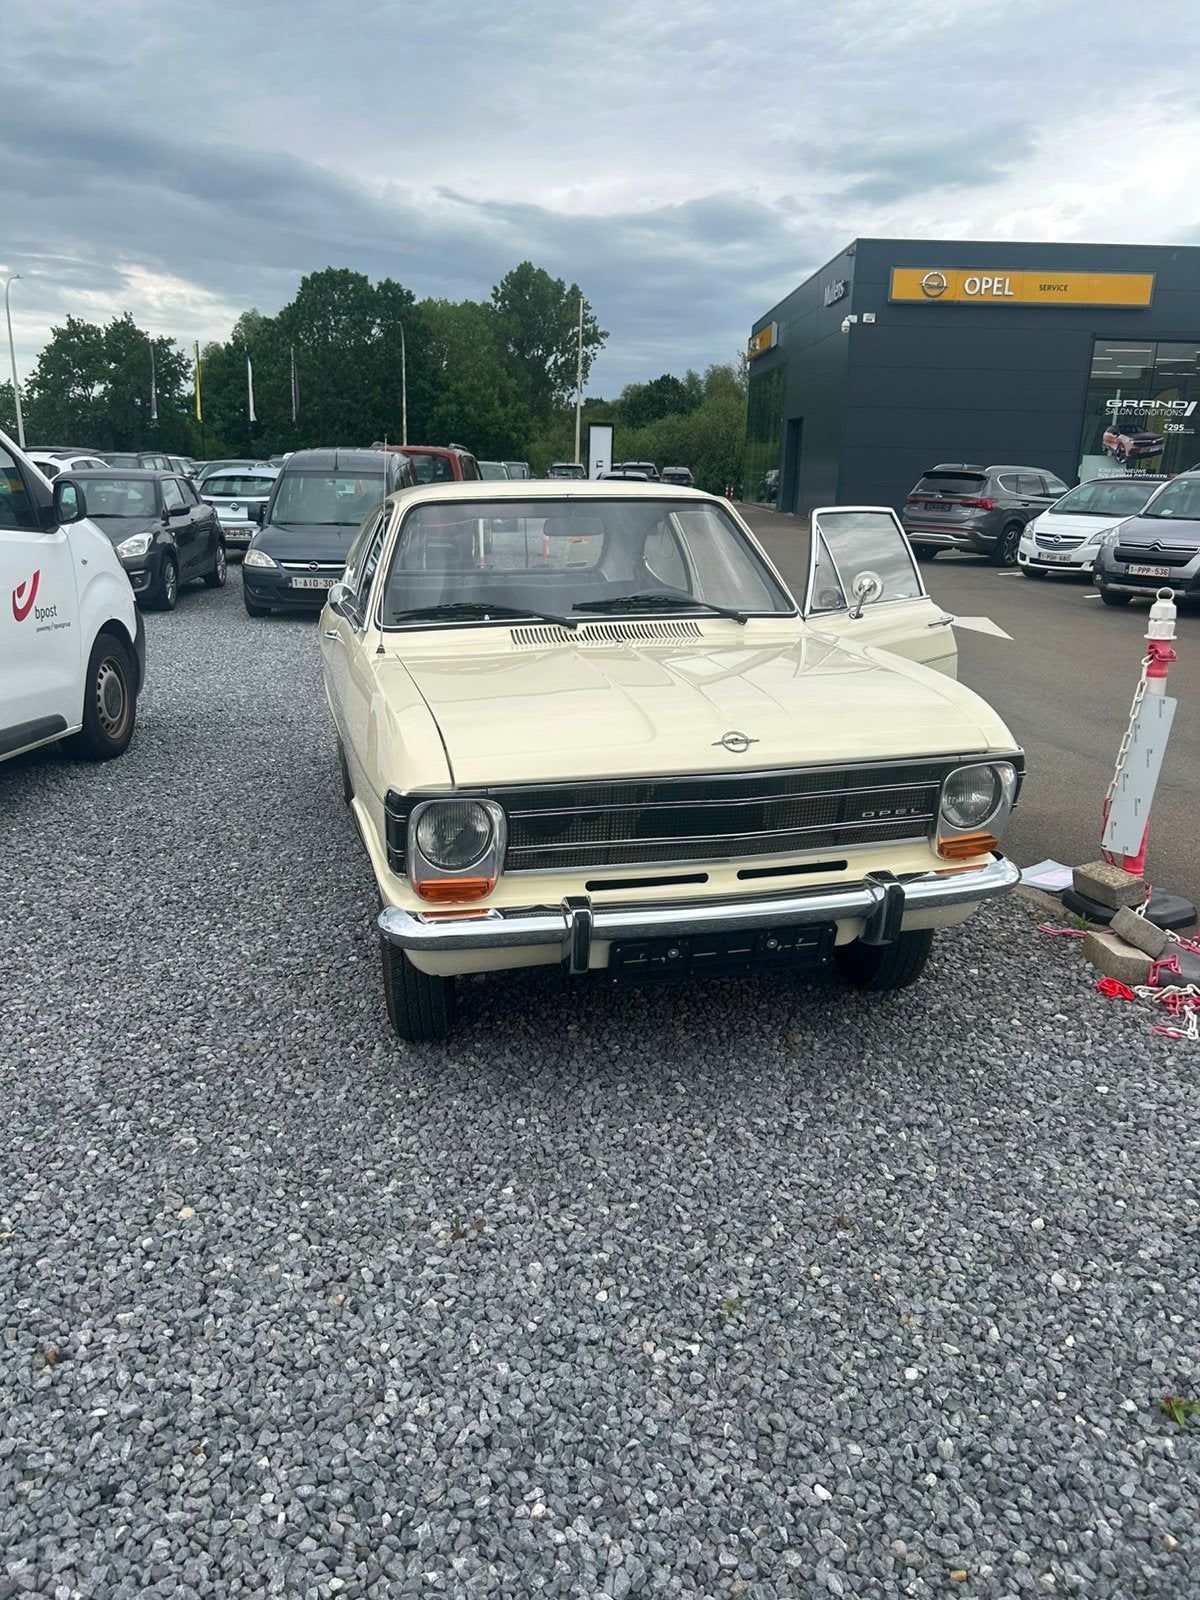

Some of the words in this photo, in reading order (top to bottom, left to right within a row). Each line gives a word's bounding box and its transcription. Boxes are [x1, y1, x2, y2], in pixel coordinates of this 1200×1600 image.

[963, 277, 1014, 296] OPEL
[1038, 284, 1069, 292] SERVICE
[1106, 400, 1188, 409] GRAND
[1105, 408, 1132, 416] SALON
[1133, 408, 1184, 417] CONDITIONS
[1129, 565, 1169, 576] 1-PPP-536
[35, 604, 58, 622] bpost
[861, 808, 921, 818] OPEL
